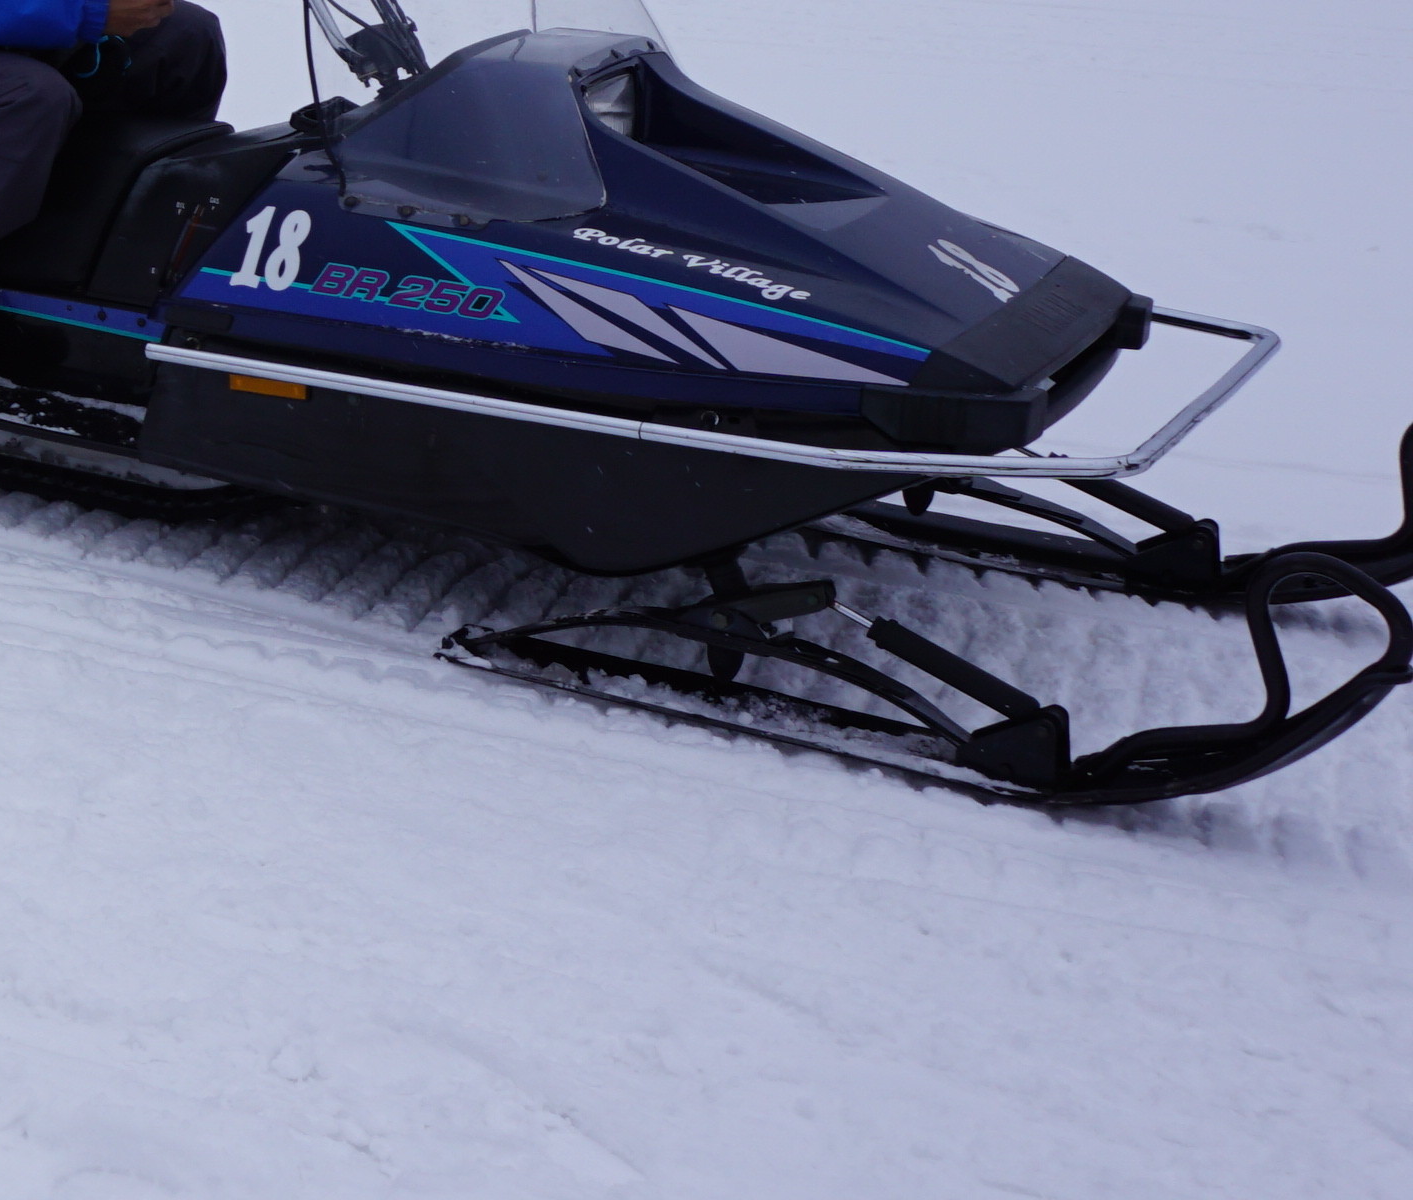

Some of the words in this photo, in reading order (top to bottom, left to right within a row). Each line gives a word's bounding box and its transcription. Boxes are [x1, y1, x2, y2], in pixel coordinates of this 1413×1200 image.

[229, 205, 312, 291] 18
[572, 227, 674, 258] Polar
[682, 254, 801, 300] Village
[309, 262, 391, 301] BR
[385, 274, 506, 320] 250
